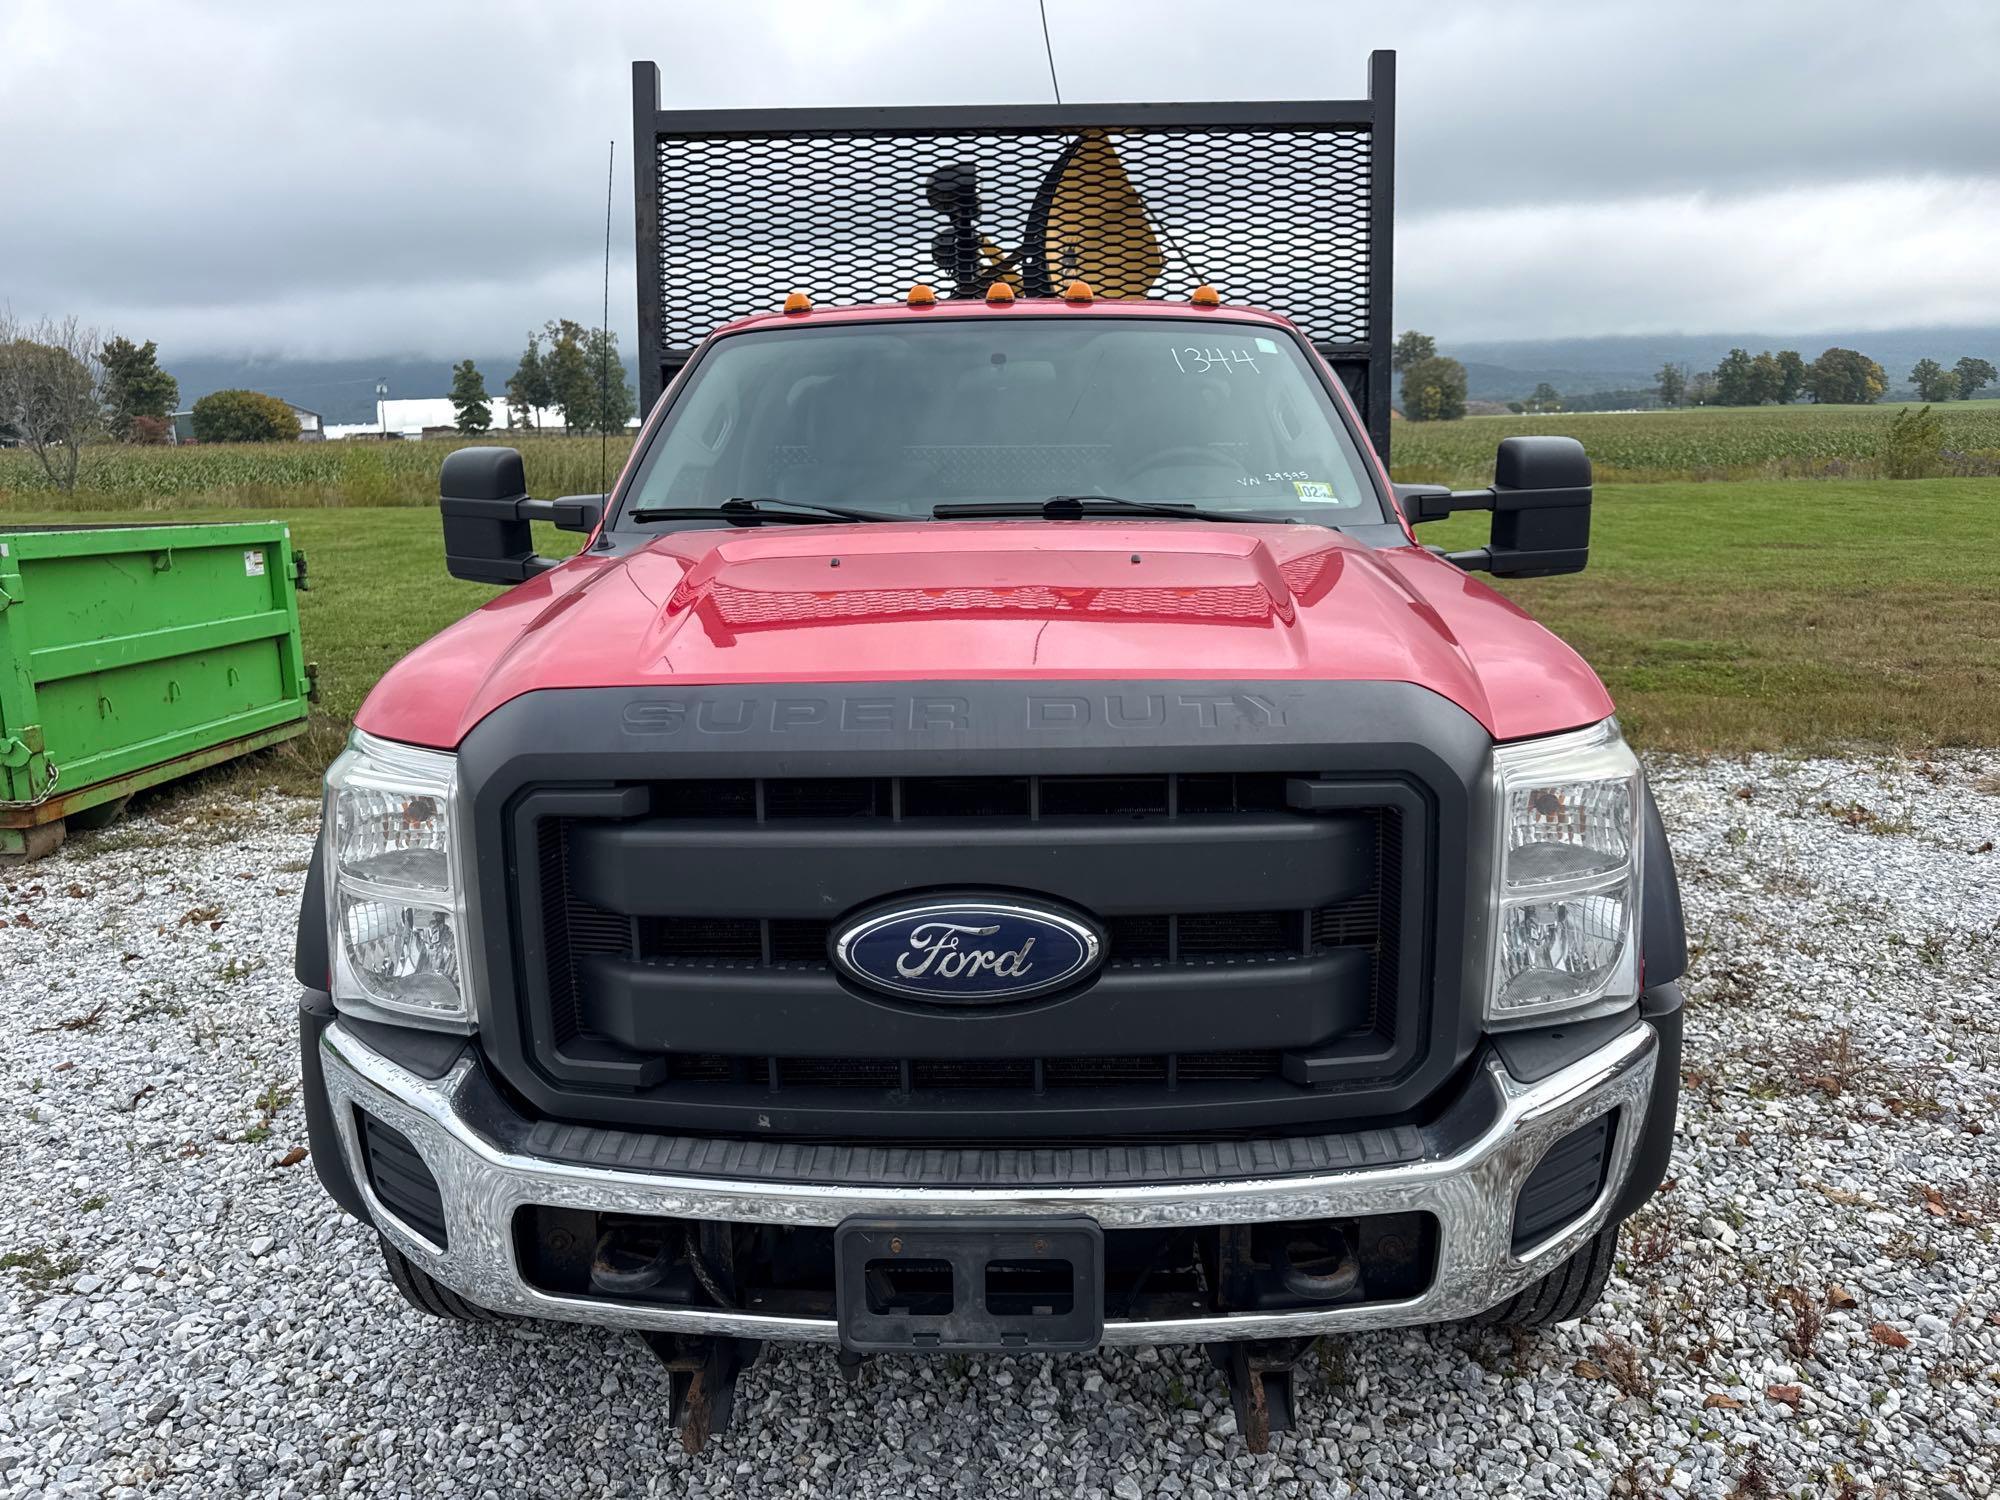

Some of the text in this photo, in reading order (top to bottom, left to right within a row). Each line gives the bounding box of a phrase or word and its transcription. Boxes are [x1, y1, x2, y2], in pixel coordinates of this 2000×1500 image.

[1171, 347, 1261, 374] 1344
[620, 695, 1304, 736] SUPER DUTY
[896, 922, 1035, 977] Ford
